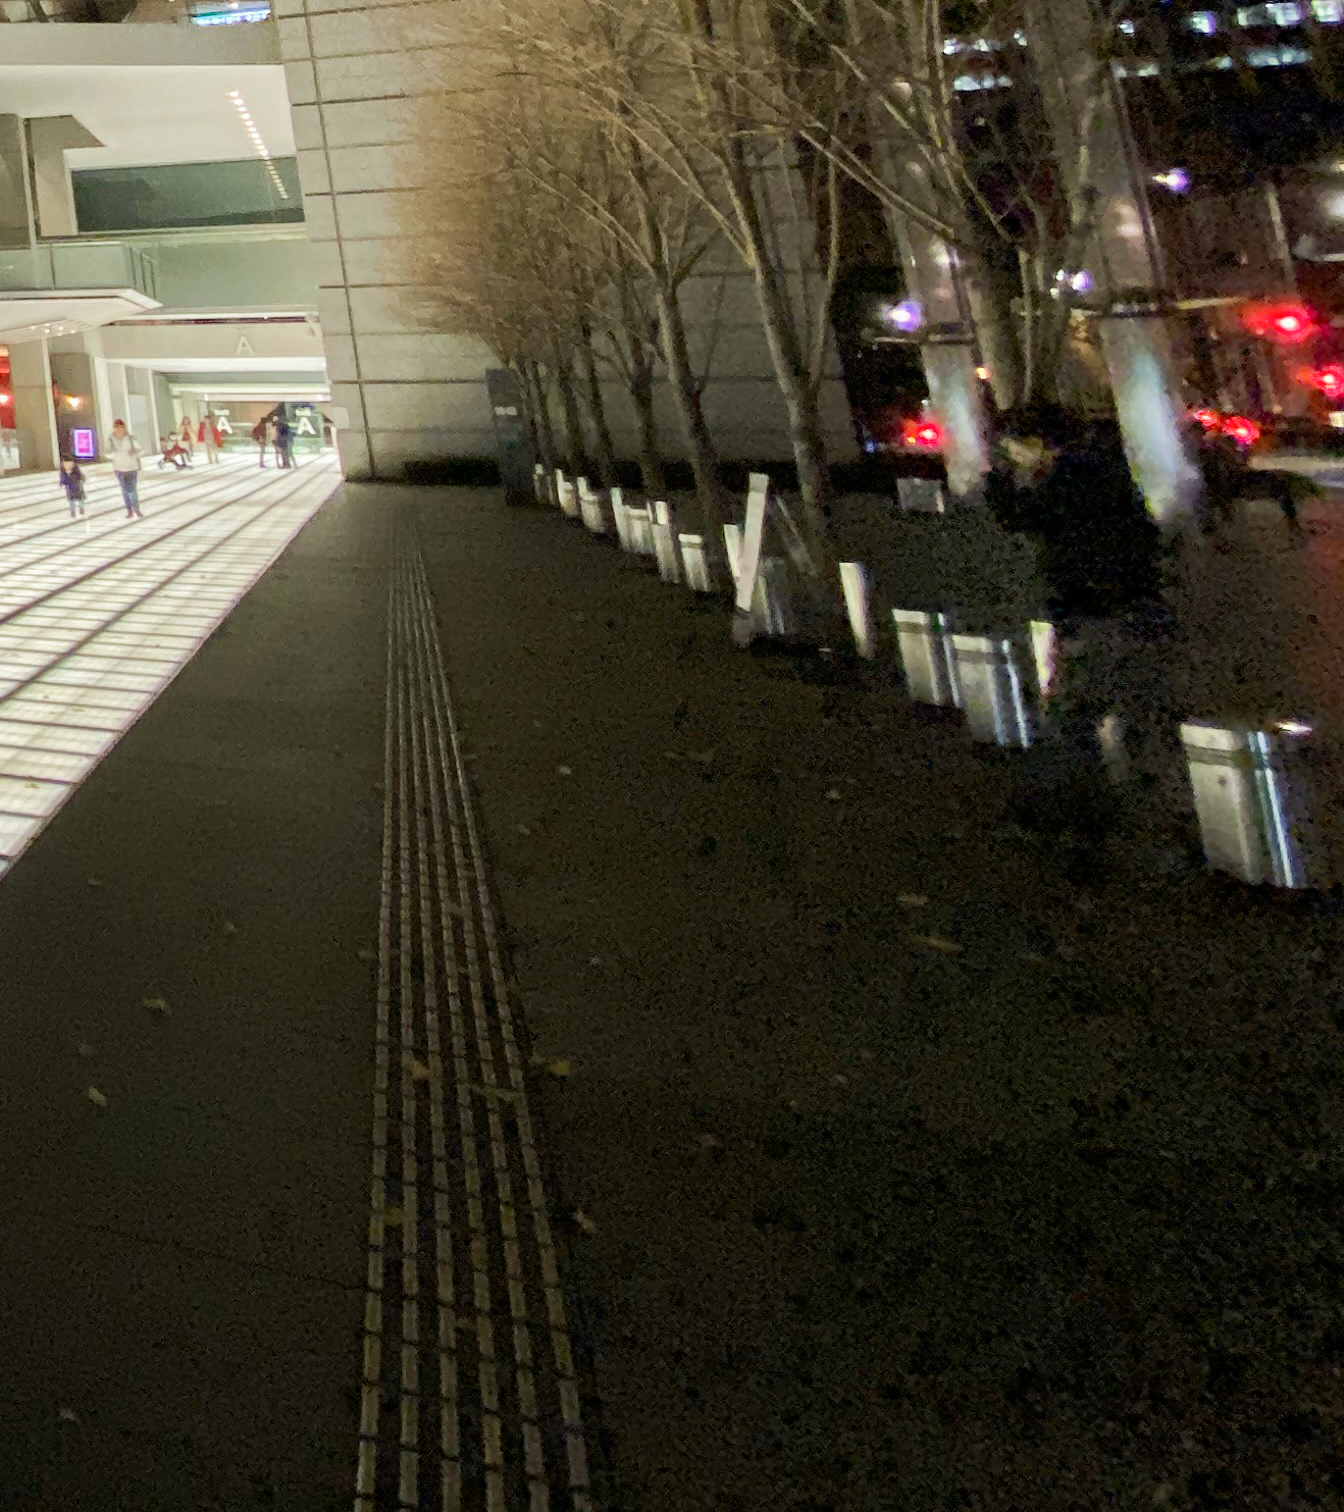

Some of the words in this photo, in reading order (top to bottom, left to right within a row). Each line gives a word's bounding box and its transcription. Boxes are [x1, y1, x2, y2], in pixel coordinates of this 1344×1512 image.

[236, 335, 255, 355] A
[216, 416, 233, 434] A
[297, 416, 315, 434] A
